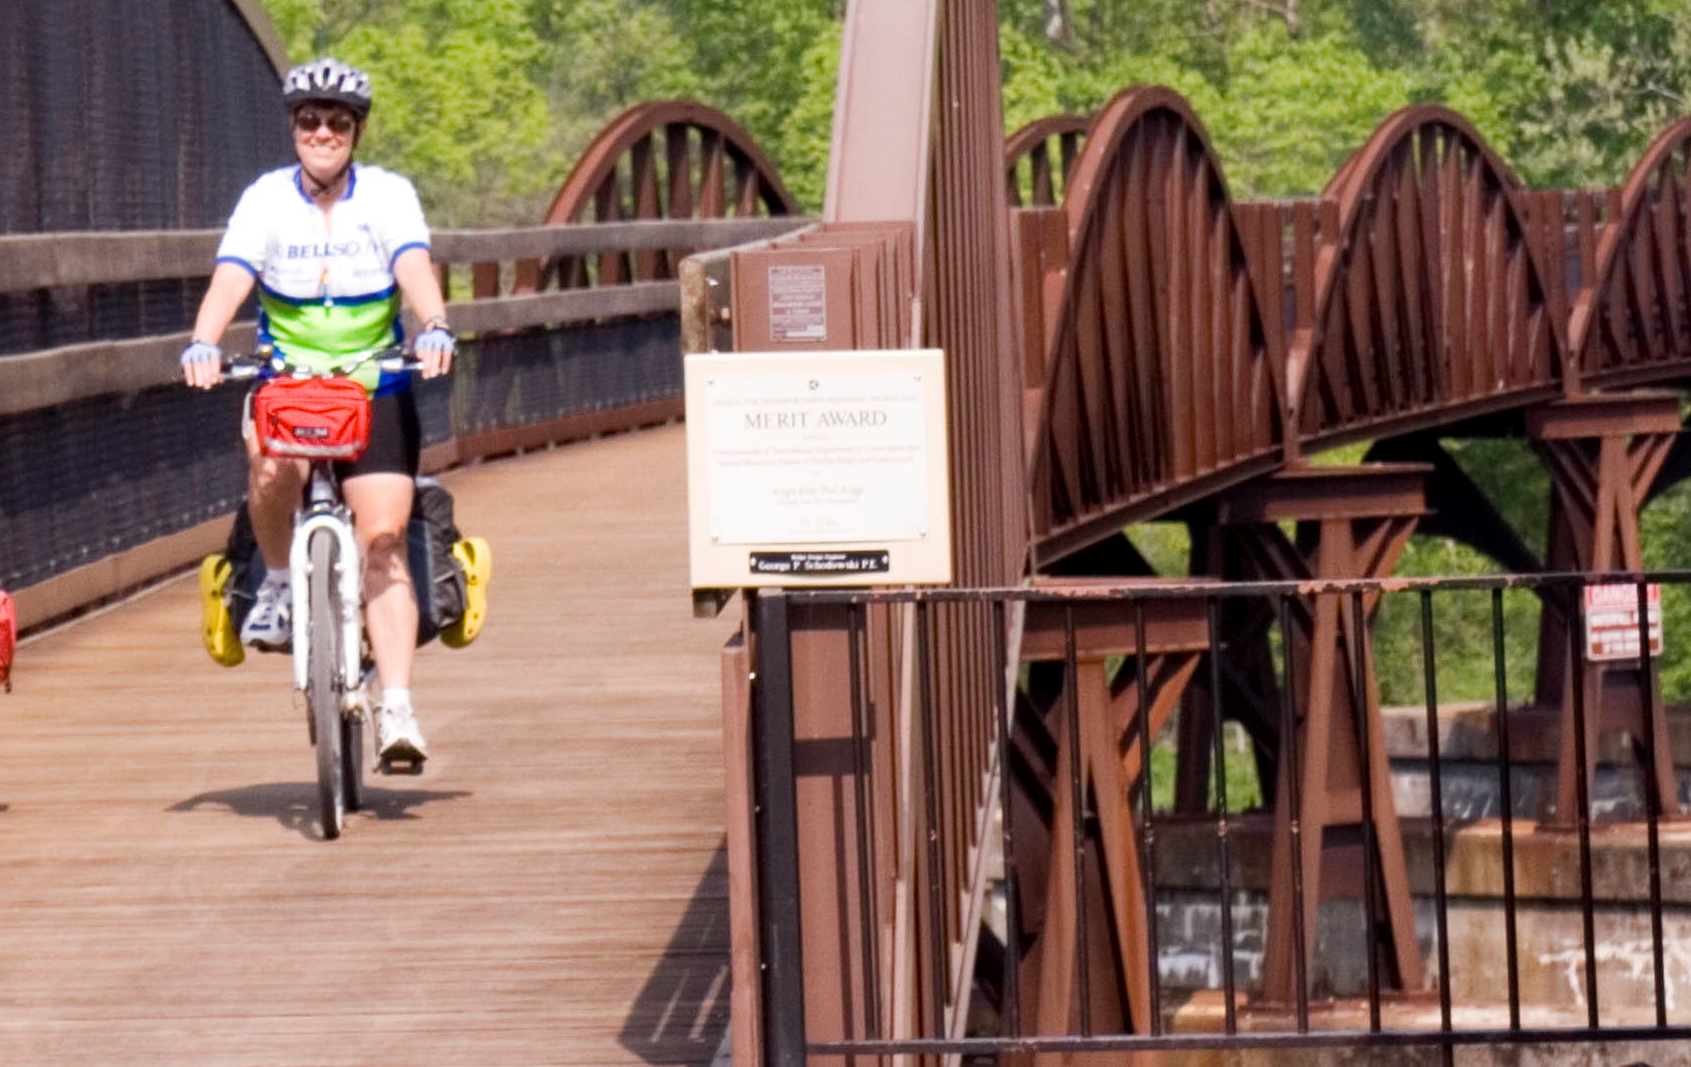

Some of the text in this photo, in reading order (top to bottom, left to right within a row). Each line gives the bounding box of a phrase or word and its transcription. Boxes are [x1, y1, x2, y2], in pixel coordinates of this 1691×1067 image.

[743, 410, 888, 430] MERIT AWARD
[758, 560, 791, 573] George
